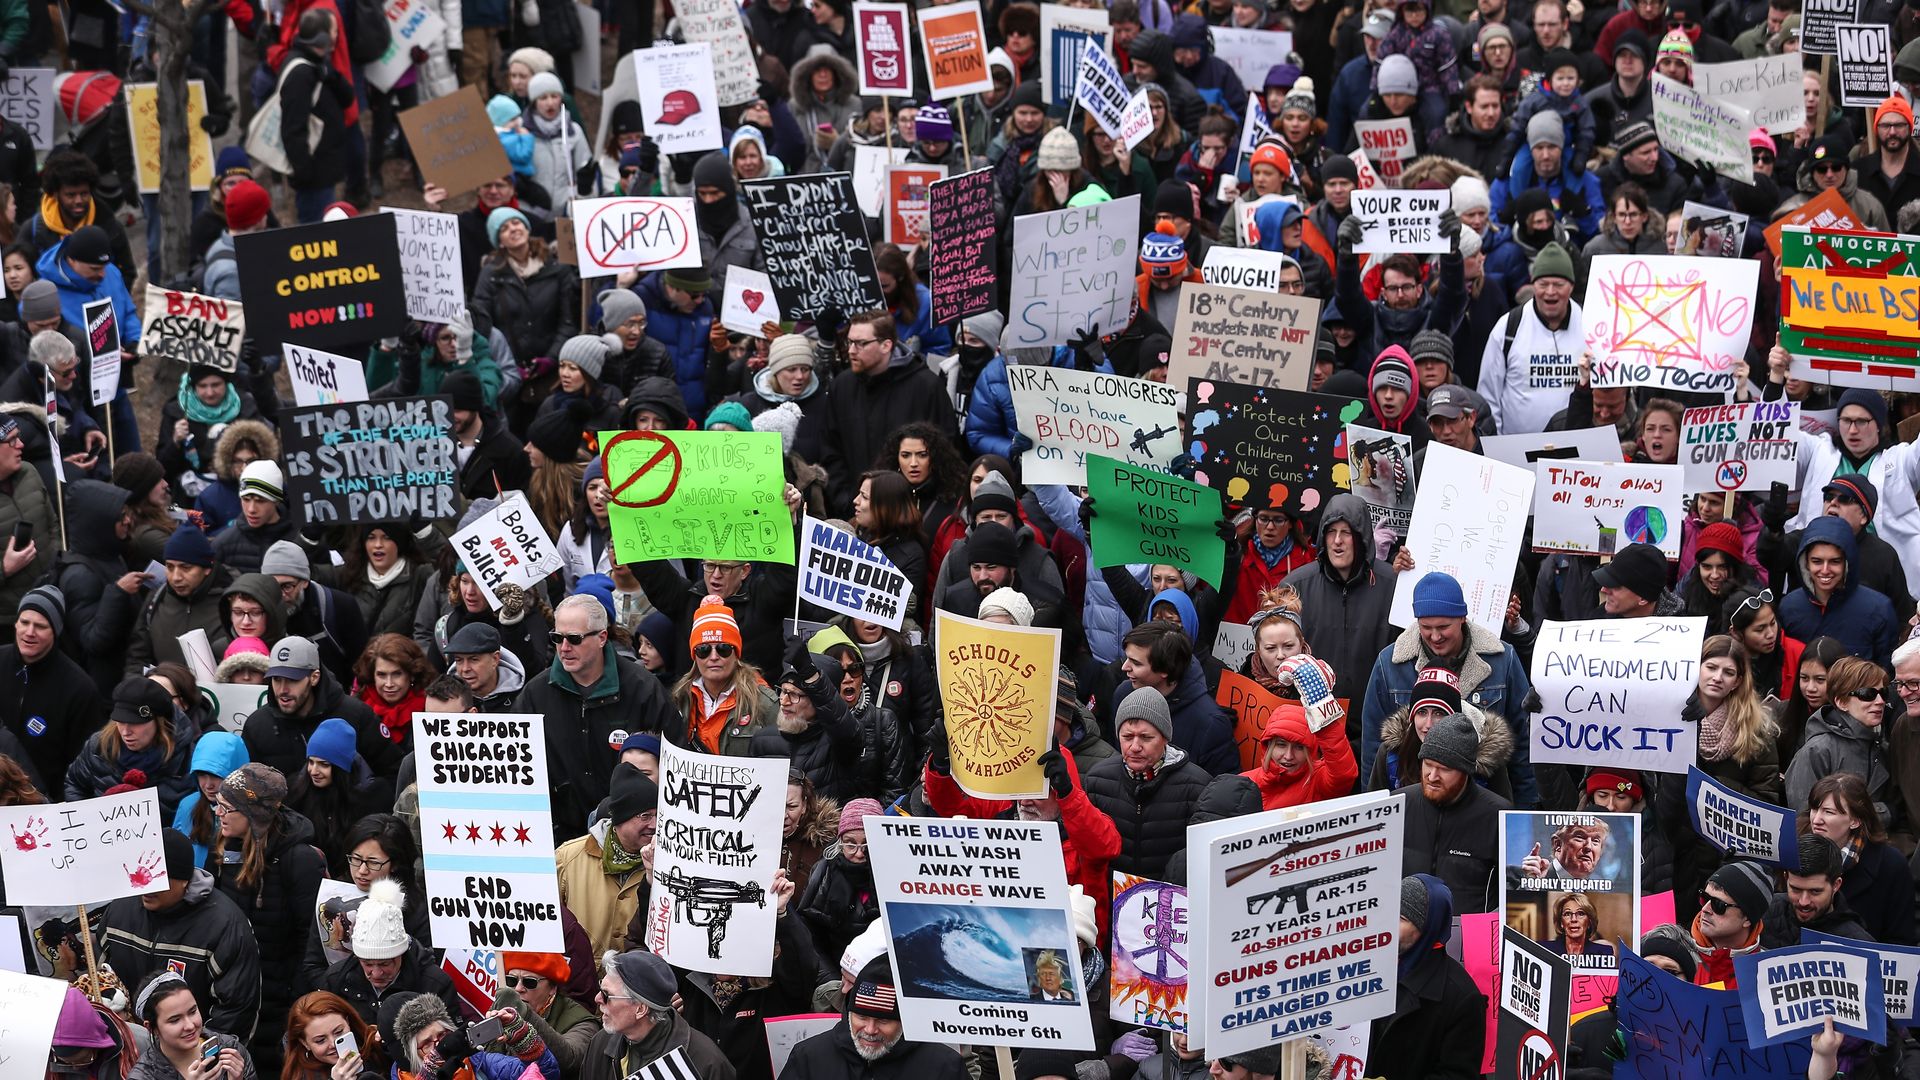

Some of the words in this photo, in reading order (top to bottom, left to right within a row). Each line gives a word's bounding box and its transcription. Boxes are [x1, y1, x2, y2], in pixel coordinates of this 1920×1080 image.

[1840, 29, 1886, 63] NO!
[935, 53, 982, 76] ACTION
[1868, 82, 1888, 91] AMERICA
[931, 183, 955, 199] THEY
[962, 202, 979, 218] BAD
[1359, 197, 1402, 215] YOUR
[1410, 199, 1439, 212] GUN
[411, 215, 457, 238] DREAM
[601, 210, 675, 252] NRA
[1046, 207, 1103, 239] UGH,
[1388, 217, 1431, 227] BIGGER
[1390, 228, 1431, 243] PENIS
[289, 240, 338, 261] GUN
[931, 243, 939, 254] A
[934, 254, 941, 265] A
[965, 242, 985, 258] BUT
[1014, 241, 1087, 274] Where
[1141, 244, 1180, 257] NYC
[276, 264, 380, 297] CONTROL
[1062, 269, 1118, 296] Even
[1203, 266, 1276, 289] ENOUGH!
[165, 290, 227, 321] BAN
[934, 304, 959, 319] TWO
[1229, 294, 1299, 327] Century
[1792, 279, 1826, 311] WE
[1832, 282, 1877, 313] CALL
[1879, 286, 1918, 322] BS
[289, 302, 374, 329] NOW!!!!
[147, 315, 239, 348] ASSAULT
[1250, 325, 1279, 339] ARE
[1280, 327, 1310, 345] NOT
[1221, 340, 1291, 370] Century
[1530, 354, 1572, 364] MARCH
[292, 349, 338, 391] Protect
[1530, 366, 1553, 376] FOR
[1555, 366, 1579, 376] OUR
[1010, 368, 1059, 391] NRA
[1068, 383, 1090, 395] and
[1094, 376, 1178, 406] CONGRESS
[1530, 378, 1562, 388] LIVES
[294, 409, 351, 437] The
[356, 400, 453, 430] POWER
[1046, 397, 1079, 414] You
[1088, 400, 1133, 425] have
[1243, 403, 1307, 428] Protect
[1683, 404, 1749, 426] PROTECT
[323, 432, 343, 445] OF
[350, 428, 382, 442] THE
[388, 424, 449, 441] PEOPLE
[1035, 414, 1119, 449] BLOOD
[1255, 424, 1290, 443] Our
[1749, 421, 1791, 440] NOT
[286, 450, 315, 477] is
[316, 436, 457, 480] STRONGER
[1037, 445, 1063, 460] on
[1235, 441, 1293, 463] Children
[1691, 443, 1728, 464] GUN
[1734, 441, 1798, 461] RIGHTS!
[321, 478, 370, 495] THAN
[375, 473, 405, 490] THE
[406, 471, 454, 486] PEOPLE
[1236, 461, 1259, 477] Not
[1268, 463, 1304, 483] Guns
[678, 488, 737, 506] WANT
[752, 490, 775, 505] TO
[1114, 468, 1201, 507] PROTECT
[1620, 478, 1662, 493] away
[303, 492, 338, 523] in
[348, 484, 457, 521] POWER
[1552, 491, 1571, 504] all
[1584, 495, 1624, 508] guns!
[1138, 502, 1178, 523] KIDS
[502, 510, 542, 562] Books
[1141, 523, 1180, 540] NOT
[490, 536, 519, 567] NOT
[1140, 540, 1191, 563] GUNS
[808, 547, 853, 581] FOR
[854, 562, 905, 598] OUR
[804, 571, 866, 611] LIVES
[1218, 632, 1235, 654] My
[1547, 625, 1620, 643] THE
[948, 643, 1036, 679] SCHOOLS
[1545, 651, 1695, 681] AMENDMENT
[1565, 685, 1627, 714] CAN
[422, 719, 451, 737] WE
[456, 720, 530, 738] SUPPORT
[1540, 716, 1623, 752] SUCK
[1632, 727, 1684, 752] IT
[430, 742, 533, 762] CHICAGO'S
[964, 746, 1036, 777] WARZONES
[433, 764, 534, 785] STUDENTS
[60, 810, 84, 830] I
[99, 800, 151, 822] WANT
[1705, 790, 1761, 827] MARCH
[881, 823, 922, 837] THE
[928, 825, 979, 839] BLUE
[984, 827, 1043, 842] WAVE
[1220, 839, 1253, 855] 2ND
[1258, 813, 1360, 847] AMENDMENT
[1365, 803, 1401, 820] 1791
[1545, 815, 1549, 826] I
[1551, 815, 1575, 826] LOVE
[1576, 815, 1595, 827] THE
[1705, 806, 1733, 833] FOR
[1736, 825, 1772, 844] OUR
[63, 838, 87, 851] TO
[909, 843, 957, 858] WILL
[961, 845, 1021, 860] WASH
[1453, 849, 1471, 857] Columbia
[52, 855, 74, 869] UP
[709, 852, 757, 868] FILTHY
[1269, 848, 1341, 876] 2-SHOTS
[1355, 838, 1387, 856] MIN
[918, 863, 972, 877] AWAY
[979, 865, 1020, 879] THE
[465, 877, 511, 899] END
[900, 881, 983, 897] ORANGE
[988, 885, 1046, 900] WAVE
[1316, 880, 1367, 902] AR-15
[1521, 878, 1559, 890] POORLY
[1560, 879, 1612, 891] EDUCATED
[431, 897, 470, 918] GUN
[474, 900, 557, 921] VIOLENCE
[1231, 926, 1260, 943] 227
[1266, 911, 1321, 934] YEARS
[1326, 897, 1379, 920] LATER
[469, 921, 525, 947] NOW
[1241, 926, 1322, 957] 40-SHOTS
[1336, 916, 1367, 933] MIN
[1214, 960, 1278, 988] GUNS
[1284, 931, 1393, 970] CHANGED
[1513, 950, 1543, 990] NO
[1235, 984, 1271, 1006] ITS
[1277, 969, 1331, 995] TIME
[1337, 959, 1371, 980] WE
[1767, 961, 1846, 985] MARCH
[1512, 986, 1540, 1014] GUNS
[1517, 978, 1531, 993] PRETTY
[1532, 987, 1541, 999] SURE
[1770, 980, 1816, 1005] FOR
[1818, 980, 1859, 1001] OUR
[958, 1004, 1028, 1022] Coming
[1221, 991, 1329, 1030] CHANGED
[1335, 978, 1383, 1001] OUR
[1510, 999, 1520, 1012] KILL
[1520, 1004, 1540, 1024] PEOPLE
[1774, 999, 1836, 1026] LIVES
[932, 1021, 1026, 1039] November
[1031, 1026, 1062, 1040] 6th
[1271, 1010, 1333, 1038] LAWS
